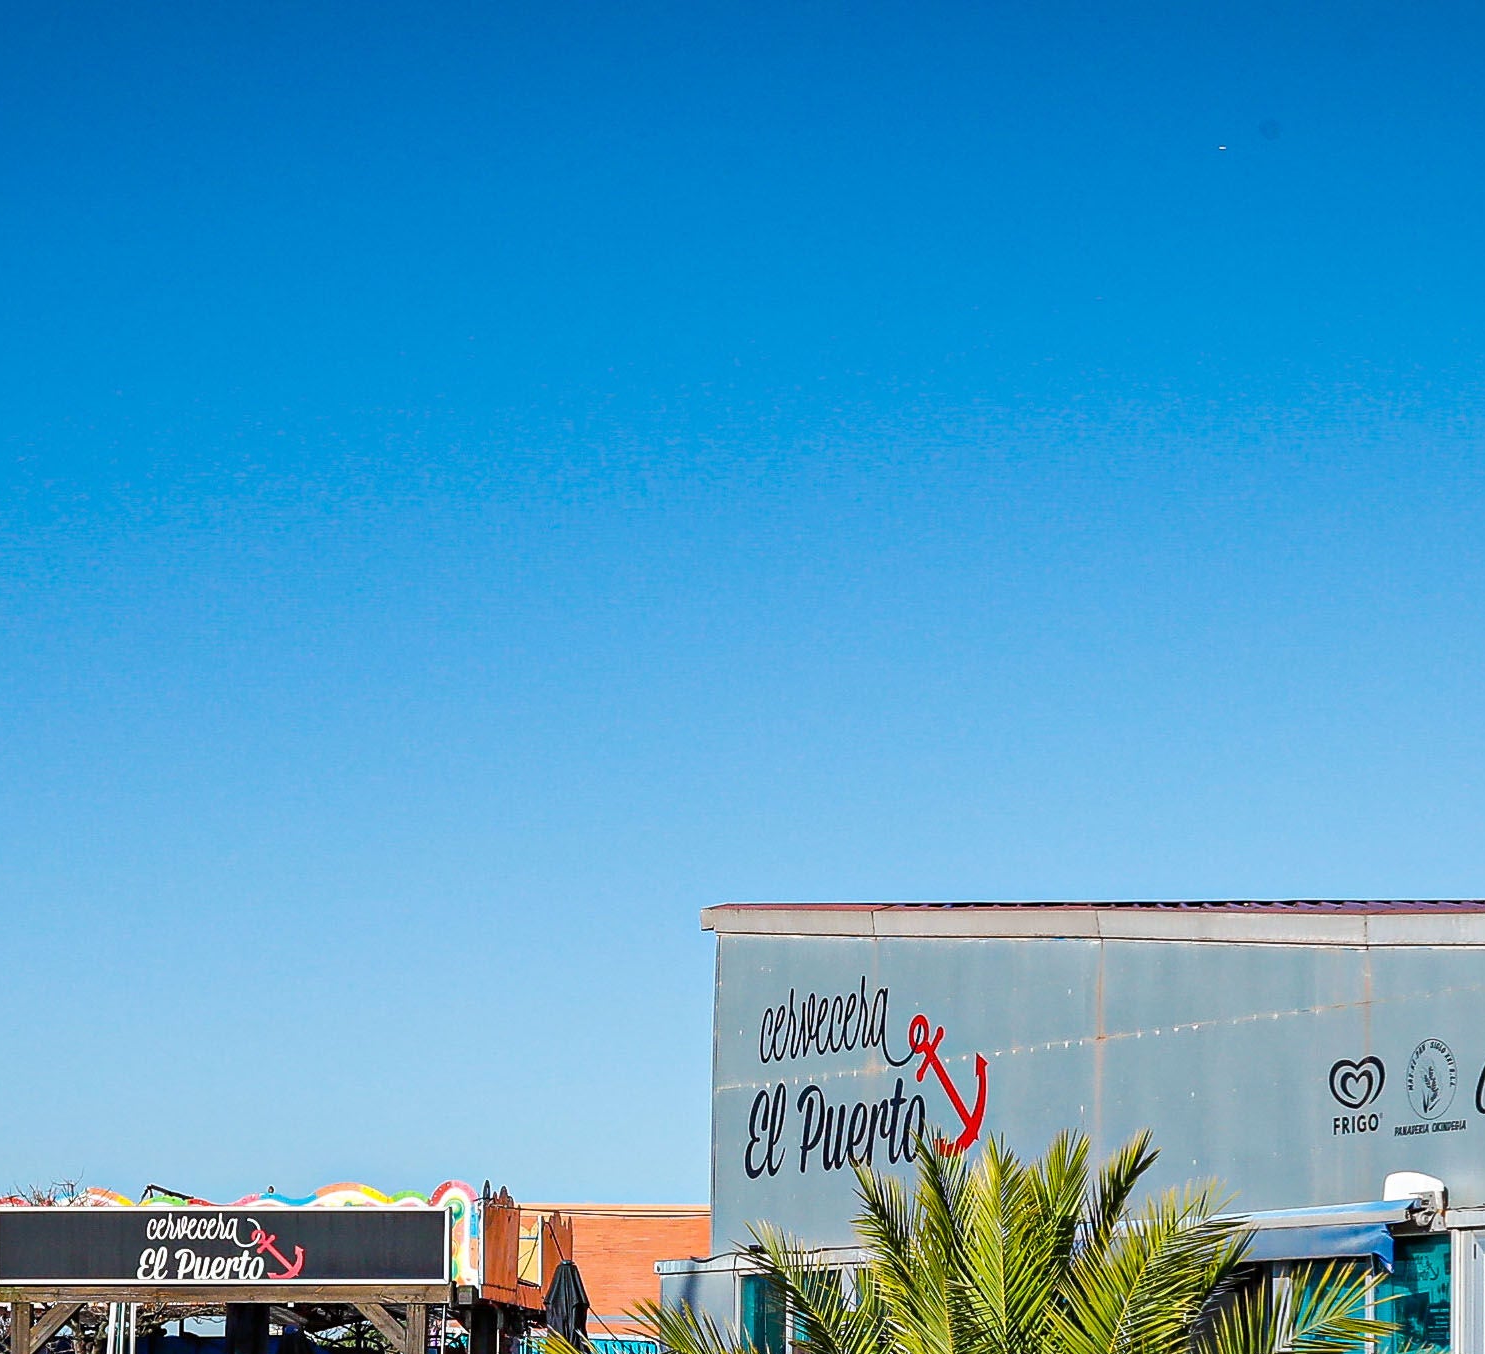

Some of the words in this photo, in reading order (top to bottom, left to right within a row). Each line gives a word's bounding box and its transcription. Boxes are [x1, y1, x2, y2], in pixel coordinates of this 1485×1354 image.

[760, 975, 922, 1067] cervecera
[744, 1082, 786, 1180] El
[796, 1077, 926, 1173] Puerto
[1332, 1113, 1380, 1136] FRIGO
[146, 1212, 261, 1248] cervecera
[136, 1247, 168, 1281] El
[175, 1248, 265, 1281] Puerto
